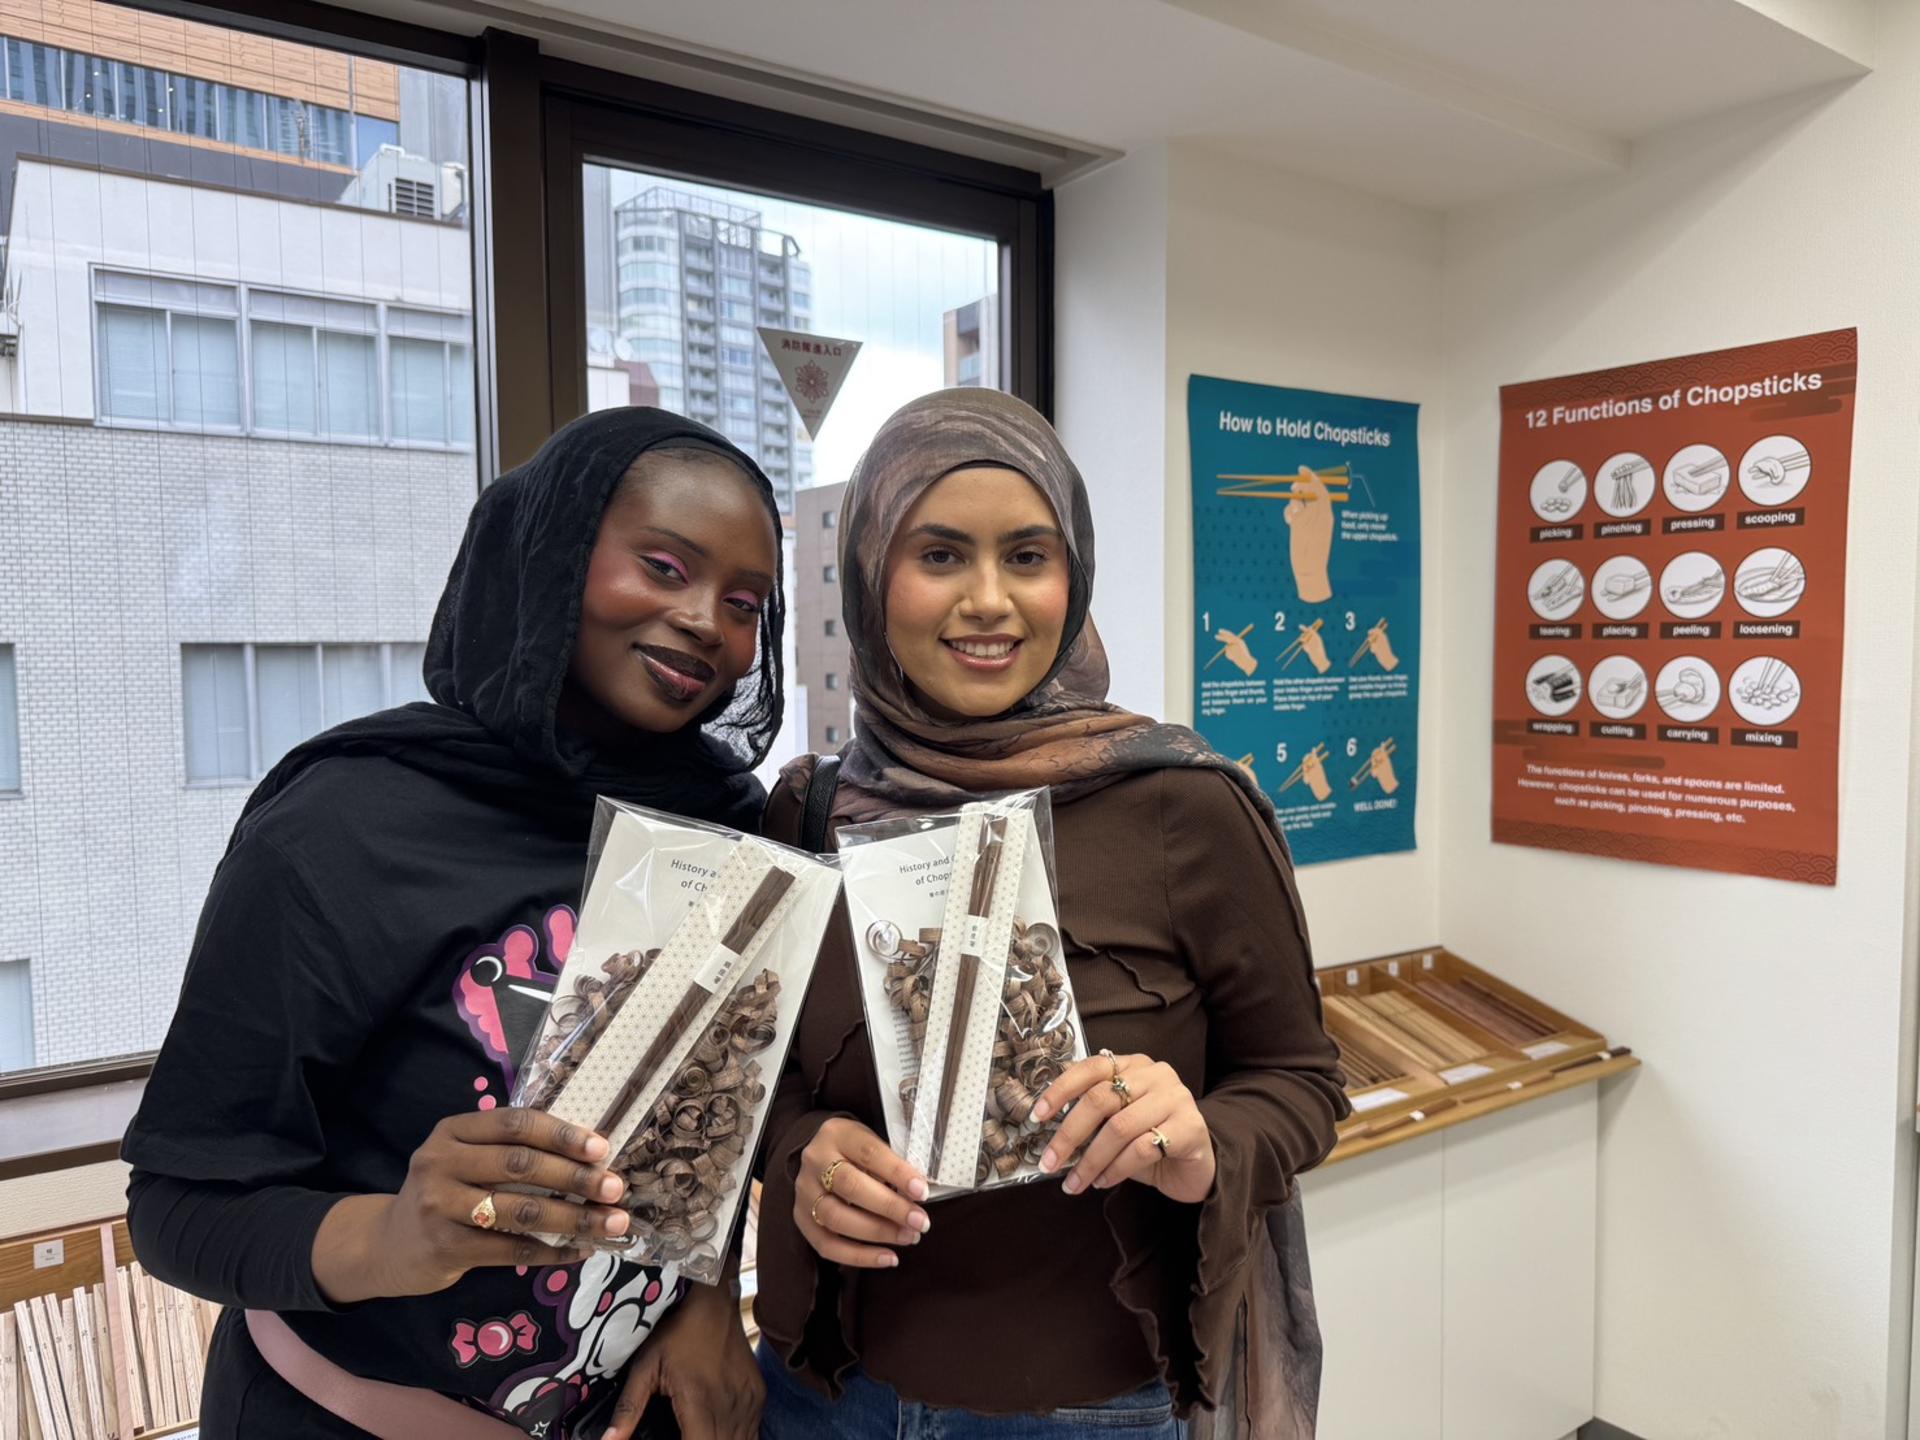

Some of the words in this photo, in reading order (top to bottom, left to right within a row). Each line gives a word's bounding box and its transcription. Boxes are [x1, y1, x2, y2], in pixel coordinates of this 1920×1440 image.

[1525, 409, 1547, 429] 12
[1552, 397, 1652, 425] Functions
[1658, 389, 1681, 411] of
[1686, 372, 1822, 407] Chopsticks
[1219, 410, 1253, 433] How
[1257, 416, 1272, 436] to
[1276, 417, 1312, 439] Hold
[1314, 421, 1391, 447] Chopsticks
[1671, 516, 1715, 531] pressing
[1745, 511, 1796, 526] scooping
[1539, 528, 1572, 540] picking
[1601, 522, 1642, 536] pinching
[1202, 612, 1210, 632] 1
[1274, 612, 1286, 631] 2
[1345, 611, 1356, 630] 3
[1603, 625, 1638, 637] placing
[1673, 624, 1711, 636] peeling
[1740, 623, 1793, 636] loosening
[1601, 725, 1634, 737] cutting
[1666, 729, 1709, 742] carrying
[1745, 733, 1783, 746] mixing
[1276, 743, 1287, 762] 5
[1346, 738, 1357, 757] 6
[1527, 764, 1542, 774] The
[1544, 765, 1585, 778] functions
[1587, 769, 1597, 778] of
[1598, 770, 1631, 782] knives,
[1632, 772, 1660, 784] forks,
[1662, 776, 1681, 786] and
[1684, 777, 1722, 790] spoons
[1724, 781, 1742, 791] are
[1744, 781, 1785, 794] limited.
[1558, 782, 1608, 795] chopsticks
[1608, 787, 1626, 796] can
[1627, 788, 1639, 797] be
[1641, 789, 1666, 800] used
[1668, 791, 1682, 801] for
[1684, 793, 1737, 806] numerous
[1740, 798, 1796, 812] purposes,
[1353, 801, 1373, 812] WELL
[1554, 797, 1576, 806] such
[1578, 799, 1588, 808] as
[1590, 800, 1626, 813] picking,
[1628, 804, 1672, 817] pinching,
[1675, 808, 1723, 823] pressing,
[1725, 812, 1746, 823] etc.
[671, 859, 708, 877] History
[899, 862, 930, 874] History
[933, 856, 950, 867] and
[681, 880, 693, 889] of
[915, 875, 924, 886] of
